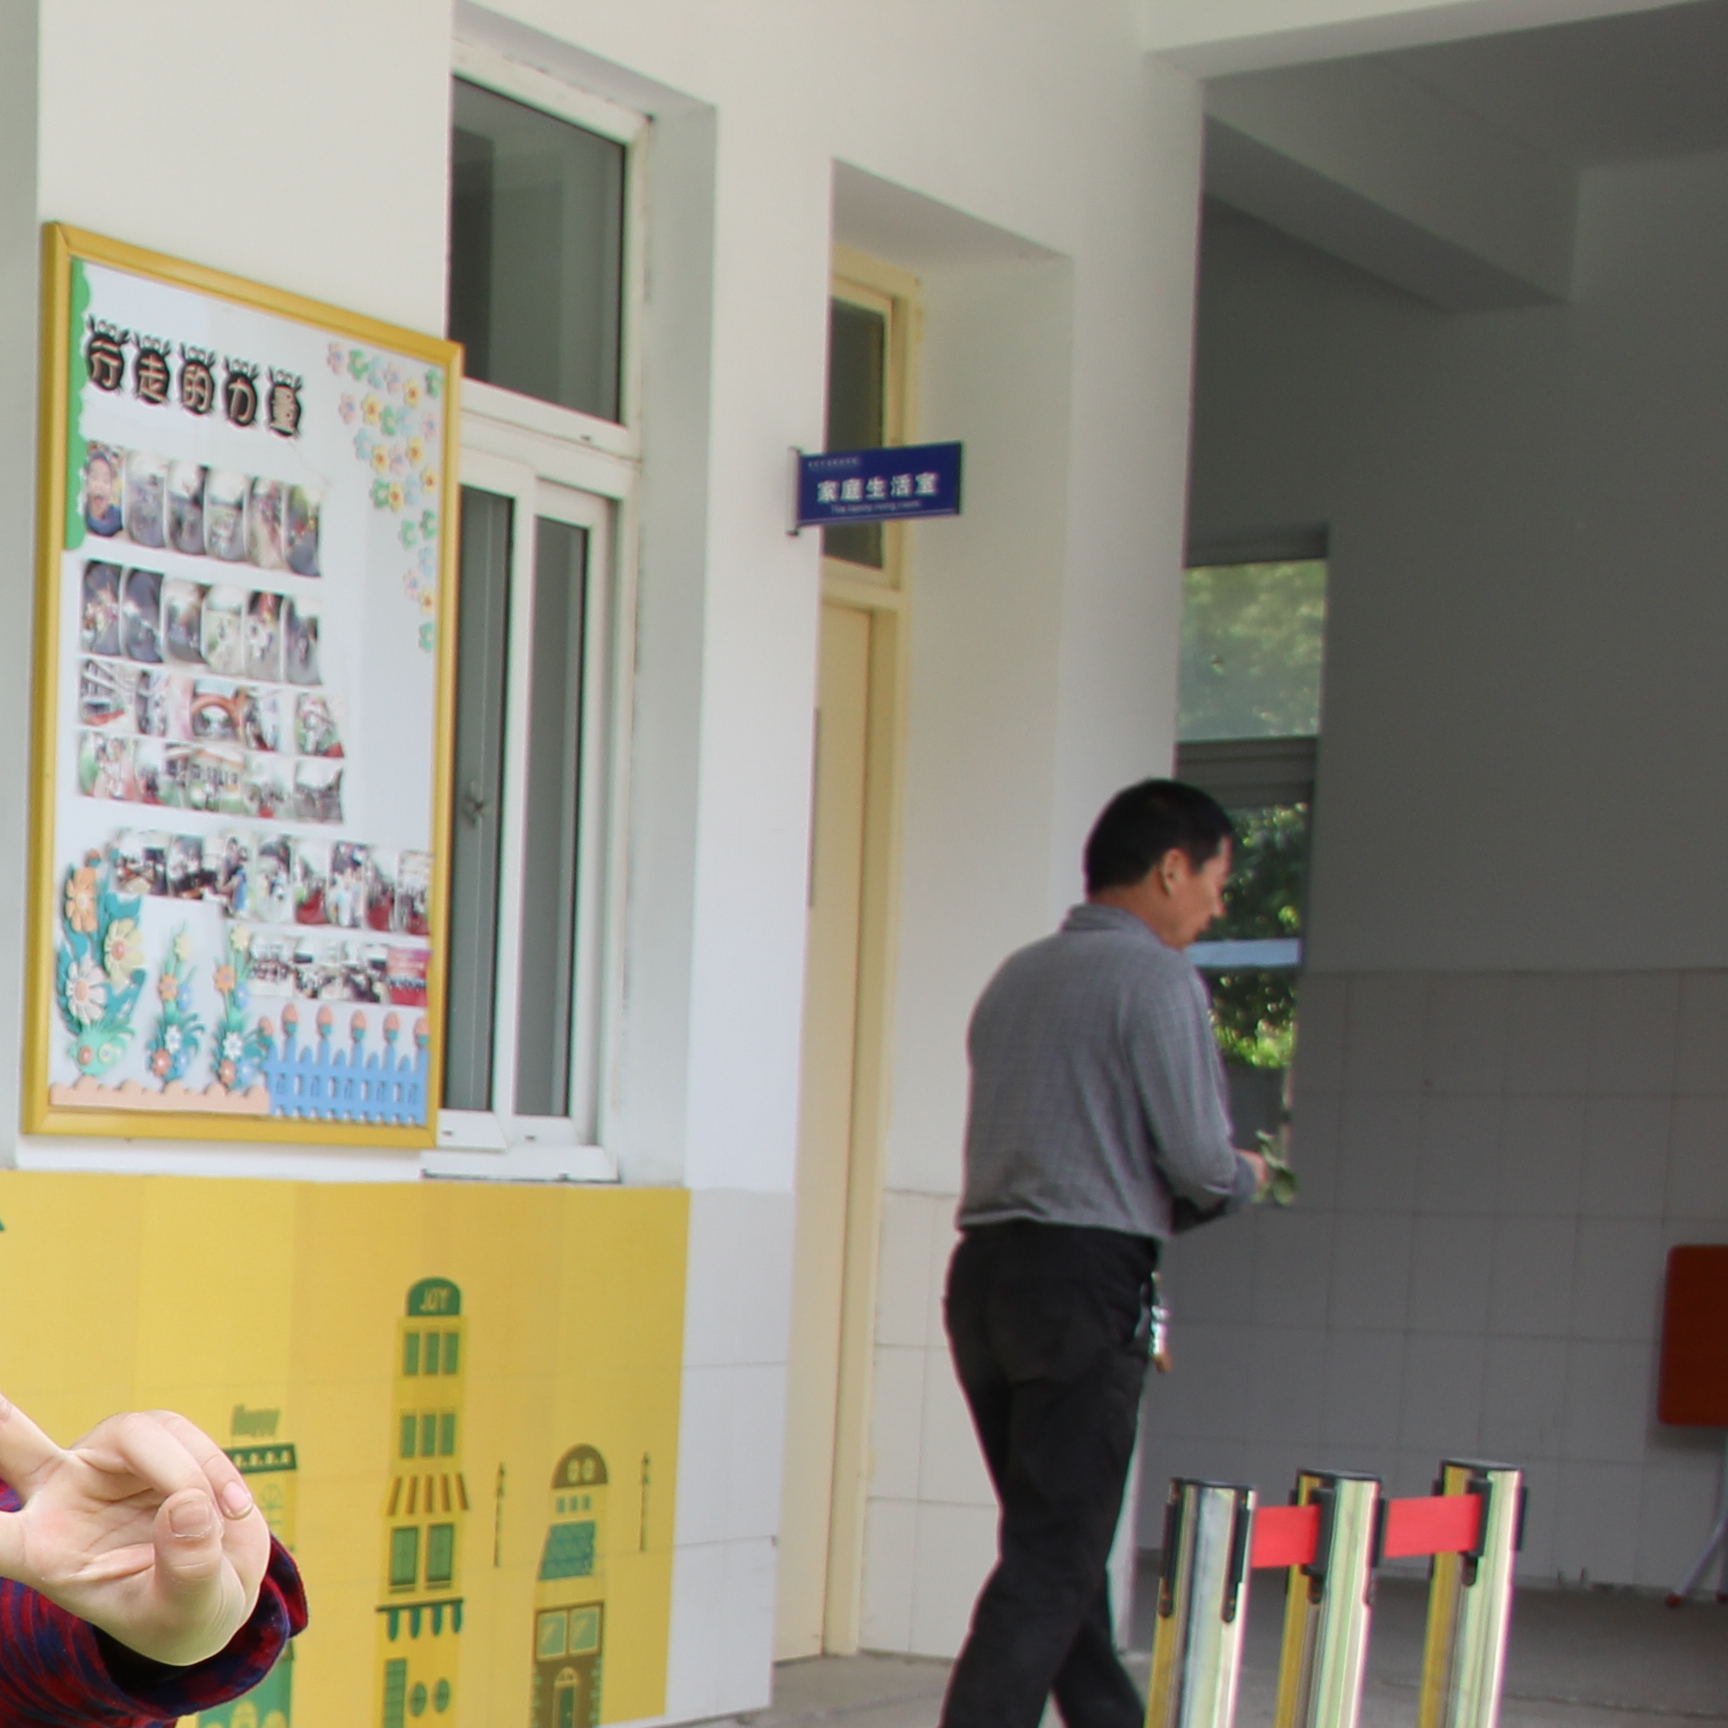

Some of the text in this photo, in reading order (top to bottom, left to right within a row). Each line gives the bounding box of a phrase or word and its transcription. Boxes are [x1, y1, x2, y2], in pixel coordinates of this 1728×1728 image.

[87, 322, 302, 438] 行走的力量
[817, 472, 939, 504] 家庭生活室
